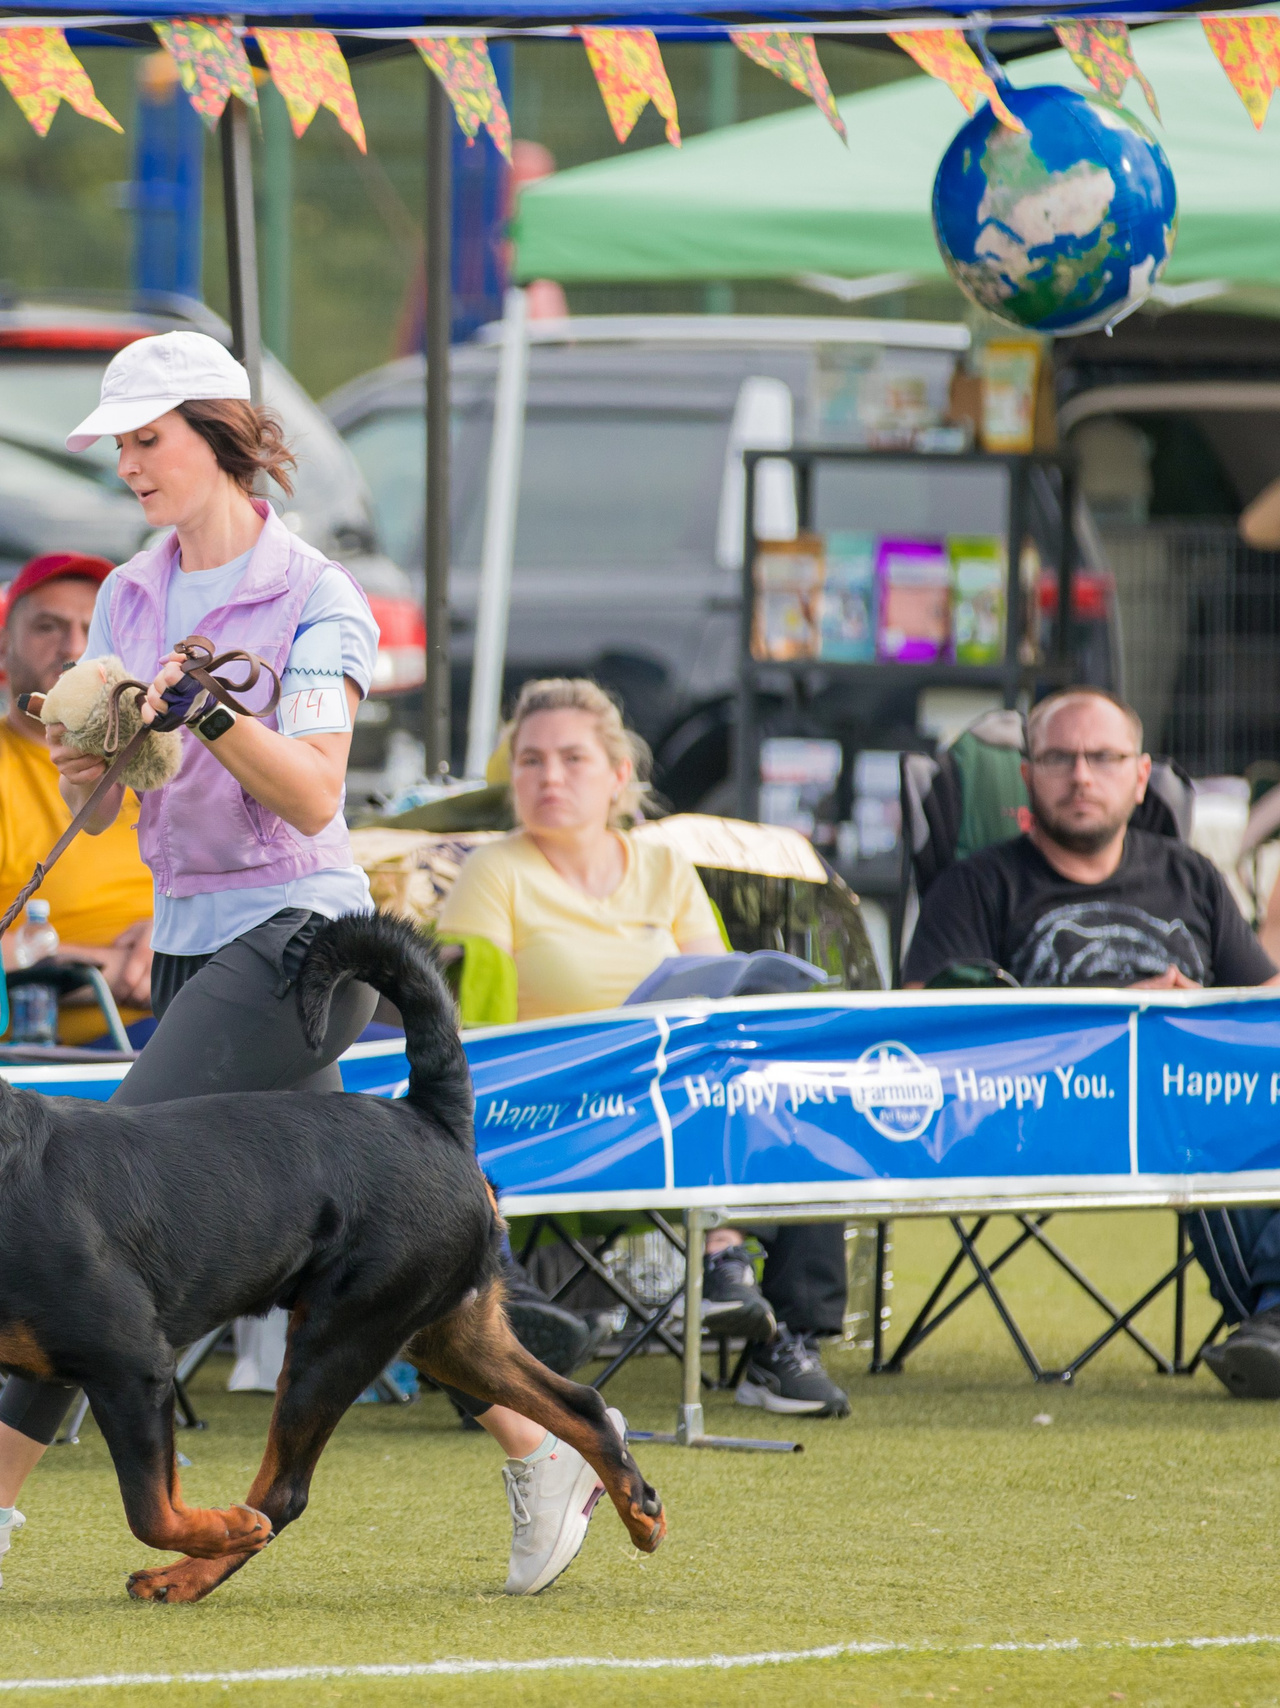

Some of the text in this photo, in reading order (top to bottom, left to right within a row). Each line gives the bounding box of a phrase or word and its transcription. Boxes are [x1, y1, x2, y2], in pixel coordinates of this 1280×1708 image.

[287, 688, 324, 724] 14
[684, 1075, 778, 1117] Happy
[955, 1065, 1115, 1109] Happy You.
[1162, 1063, 1259, 1105] Happy
[483, 1092, 637, 1131] Happy You.
